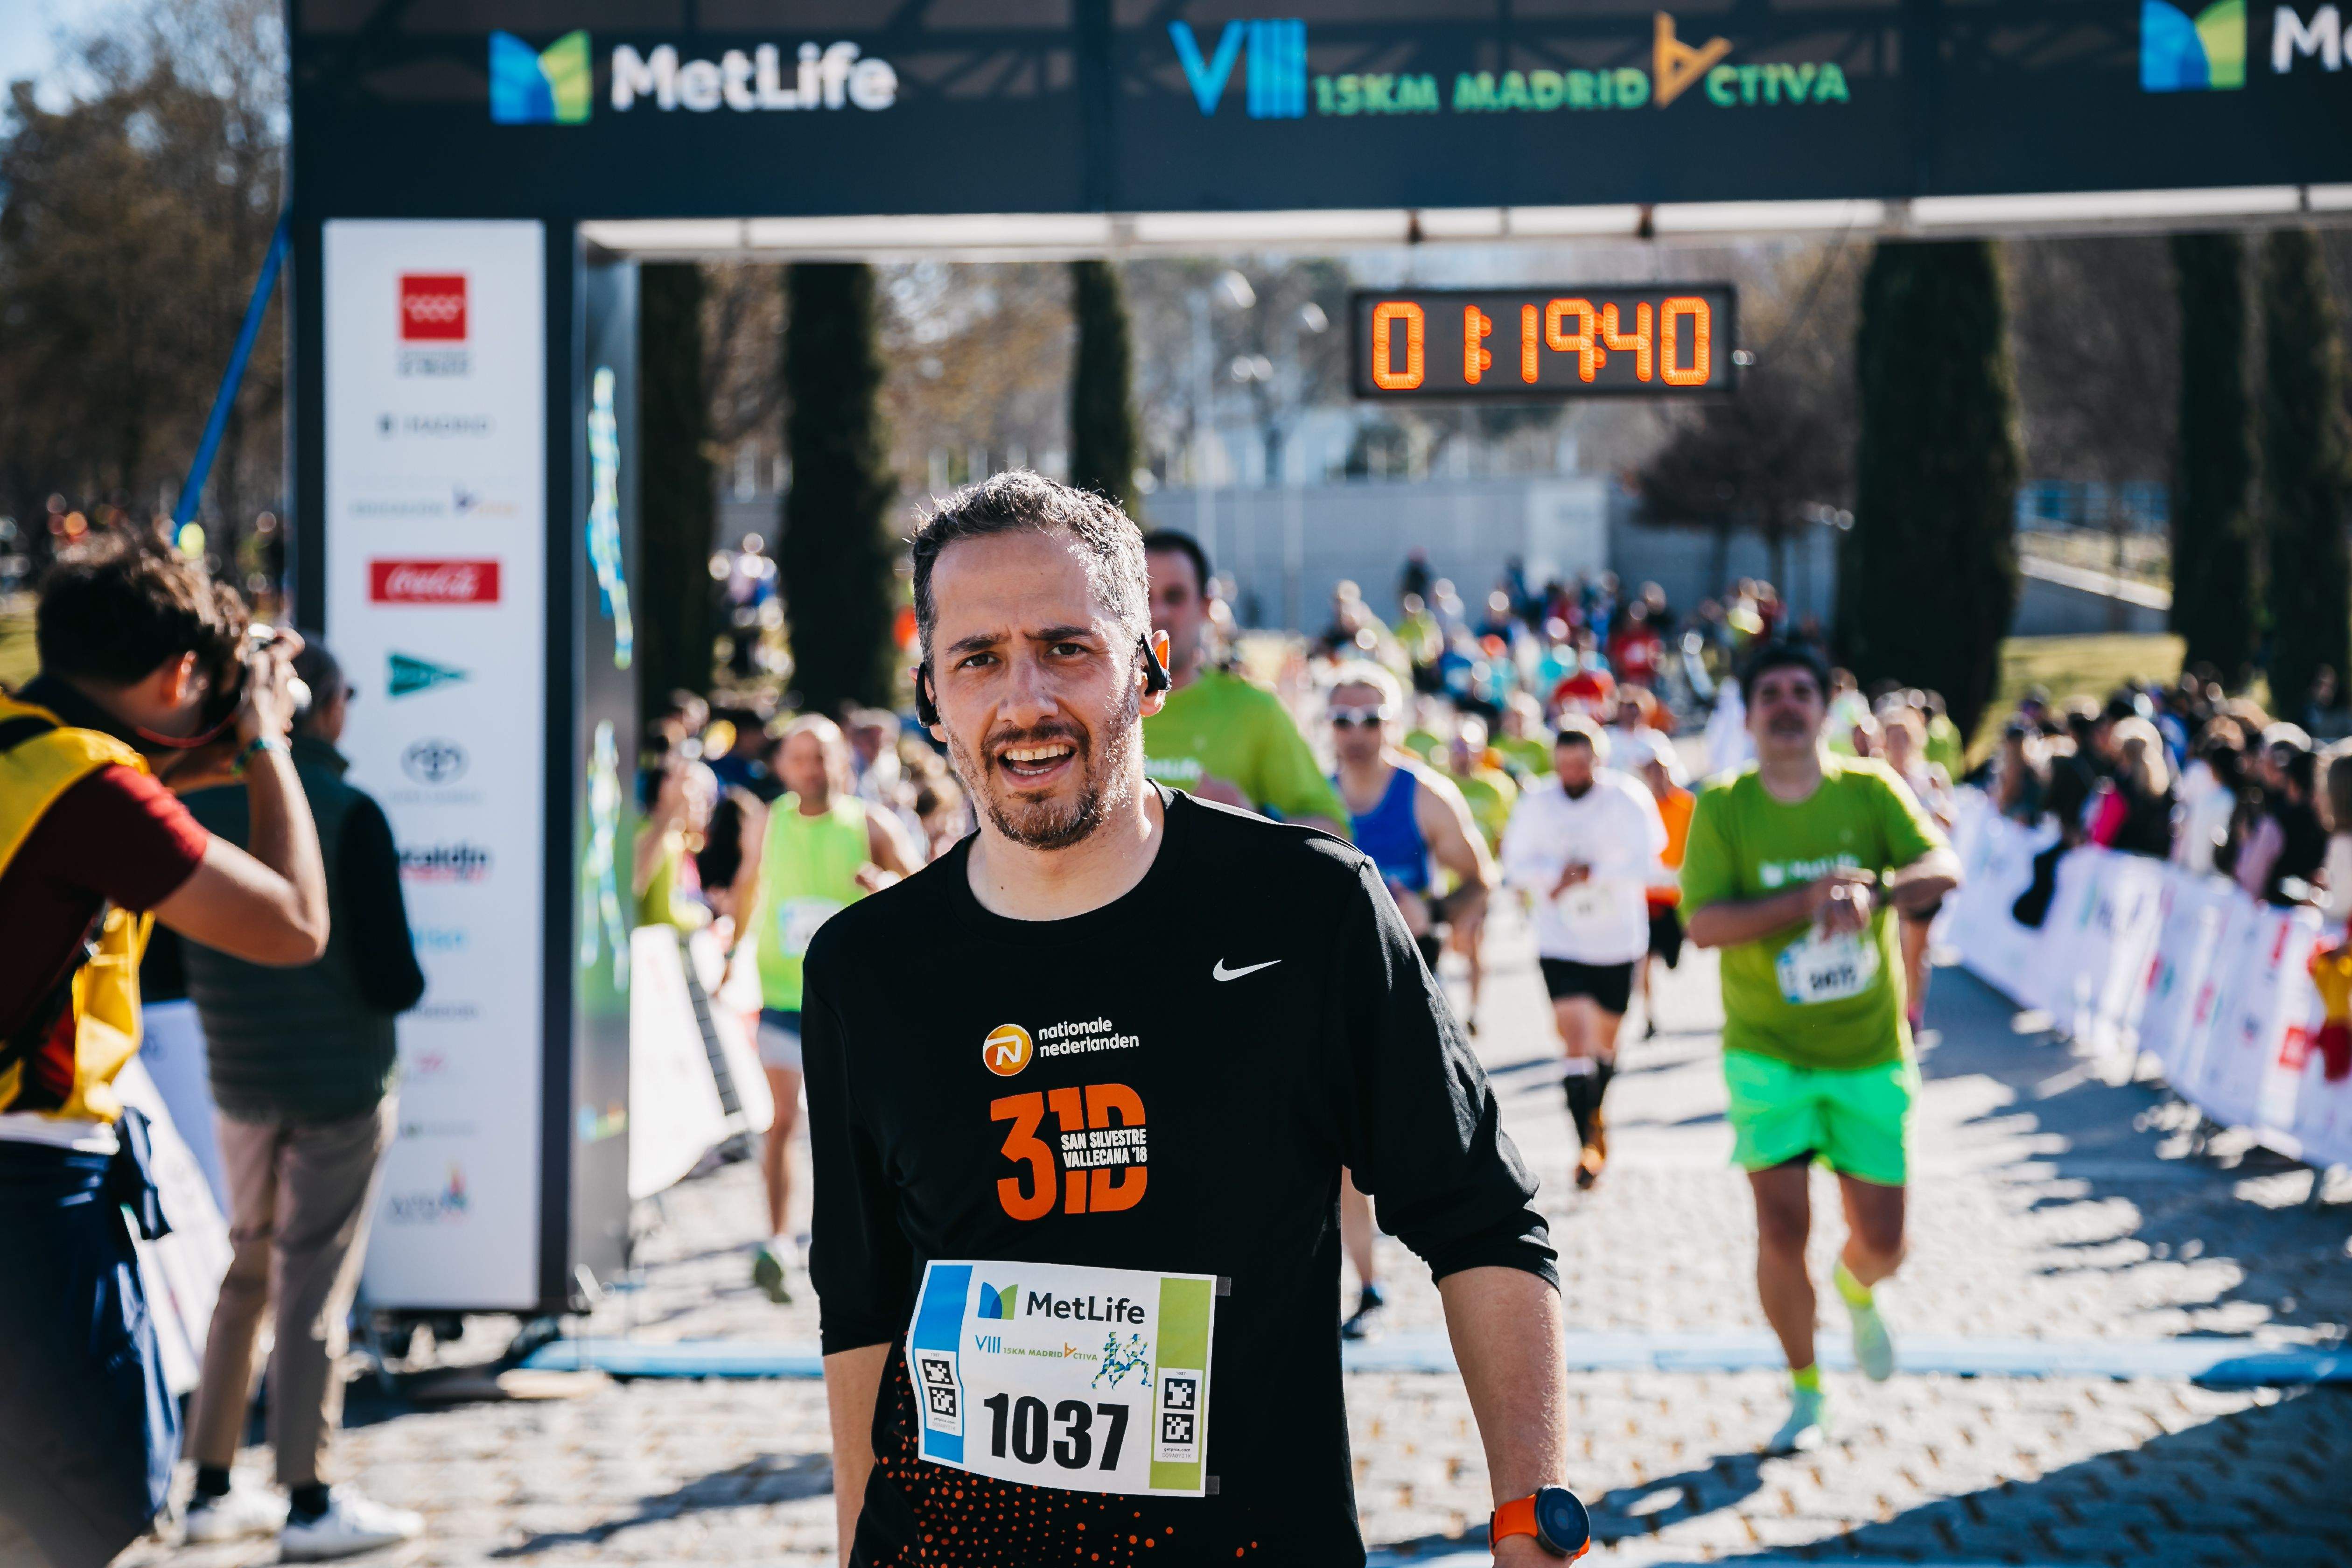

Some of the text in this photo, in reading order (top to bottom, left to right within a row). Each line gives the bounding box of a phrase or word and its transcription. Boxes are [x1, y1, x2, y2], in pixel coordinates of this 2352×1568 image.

[2271, 5, 2352, 74] M
[610, 41, 897, 112] MetLife
[1168, 19, 1307, 119] VIII
[1315, 73, 1439, 115] 15KM
[1452, 68, 1651, 111] MADRID
[1039, 1017, 1112, 1041] nationale
[1040, 1033, 1139, 1057] nederlanden
[1061, 1128, 1147, 1150] SAN SILVESTRE
[1063, 1146, 1147, 1168] VALLECANA '18
[1027, 1291, 1145, 1324] MetLife
[975, 1335, 1001, 1354] VIII
[1028, 1349, 1063, 1358] MADRID
[984, 1393, 1129, 1471] 1037
